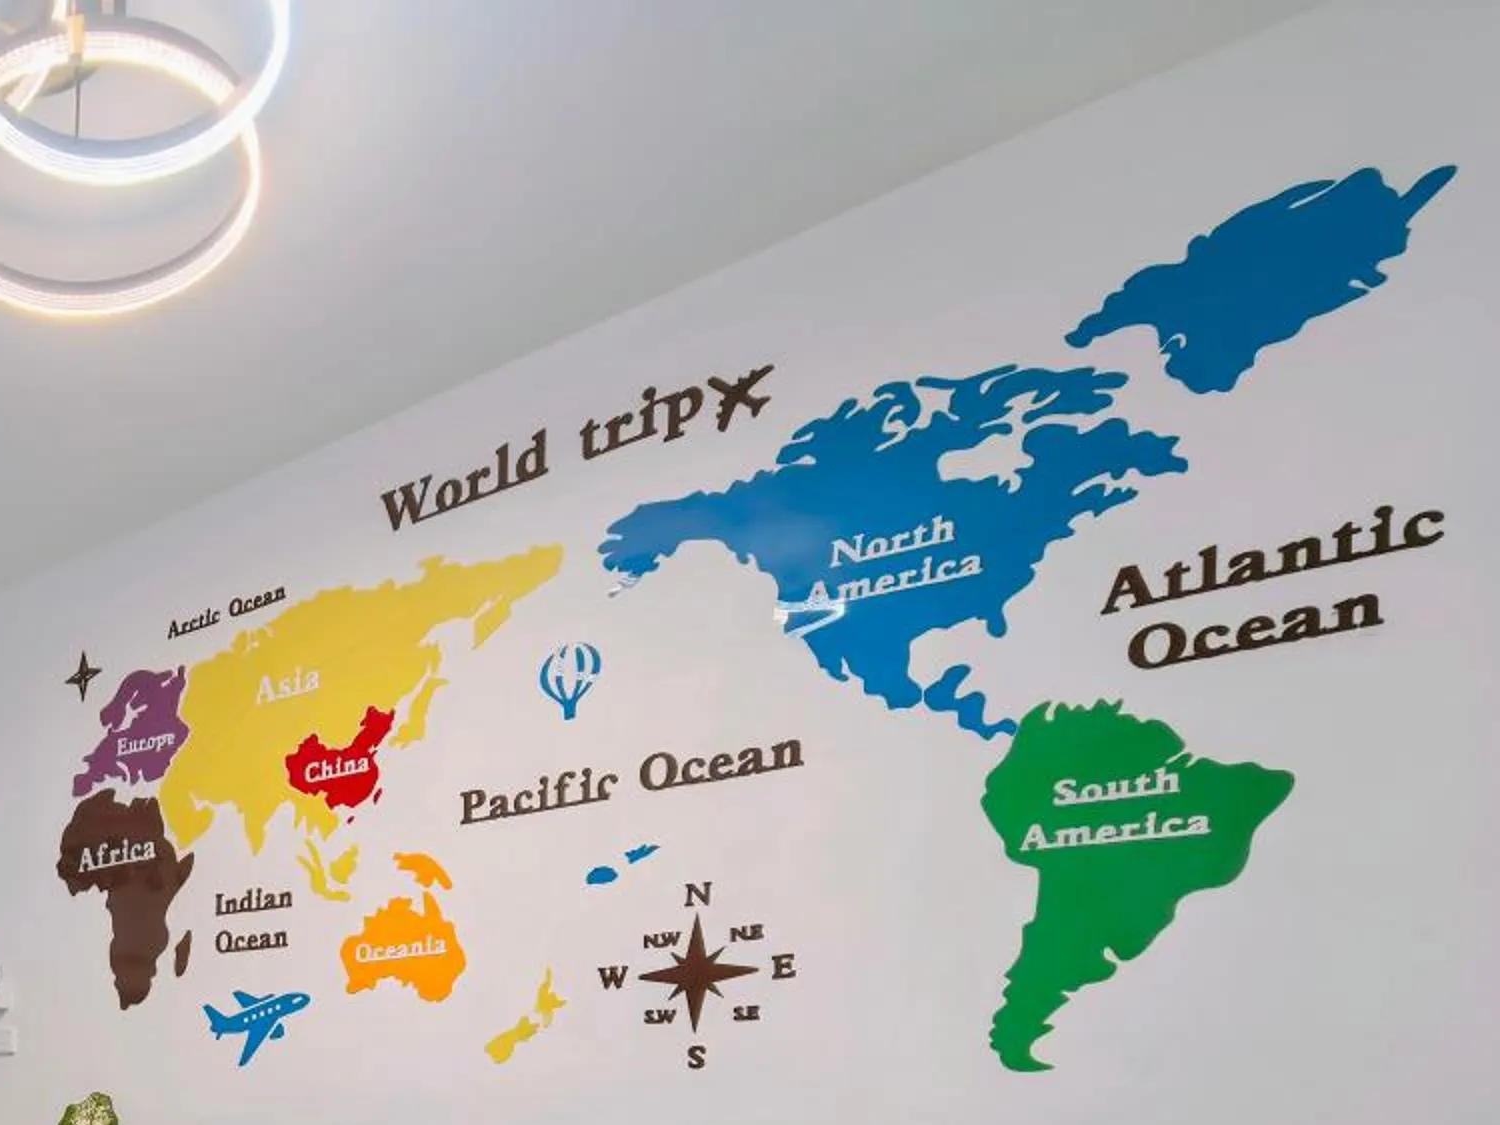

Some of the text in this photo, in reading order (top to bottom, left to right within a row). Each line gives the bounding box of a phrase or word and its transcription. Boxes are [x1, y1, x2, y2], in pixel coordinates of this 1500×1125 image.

[380, 386, 704, 531] World trip
[828, 514, 955, 569] North
[1100, 505, 1445, 614] Atlantic
[805, 552, 984, 610] America
[167, 586, 287, 639] Arctic Ocean
[1127, 590, 1384, 671] Ocean
[256, 667, 321, 704] Asia
[116, 731, 175, 757] Europe
[304, 755, 370, 783] China
[459, 738, 805, 825] Pacific Ocean
[1052, 767, 1180, 806] South
[1019, 812, 1212, 852] America
[78, 839, 156, 873] Africa
[214, 888, 293, 916] Indian
[684, 881, 712, 907] N
[214, 931, 289, 953] Ocean
[643, 931, 682, 949] NW
[729, 923, 765, 942] NE
[355, 935, 448, 963] Oceania
[598, 965, 629, 990] W
[771, 953, 797, 980] E
[643, 1009, 677, 1025] SW
[732, 1005, 761, 1021] SE
[687, 1045, 706, 1070] S
